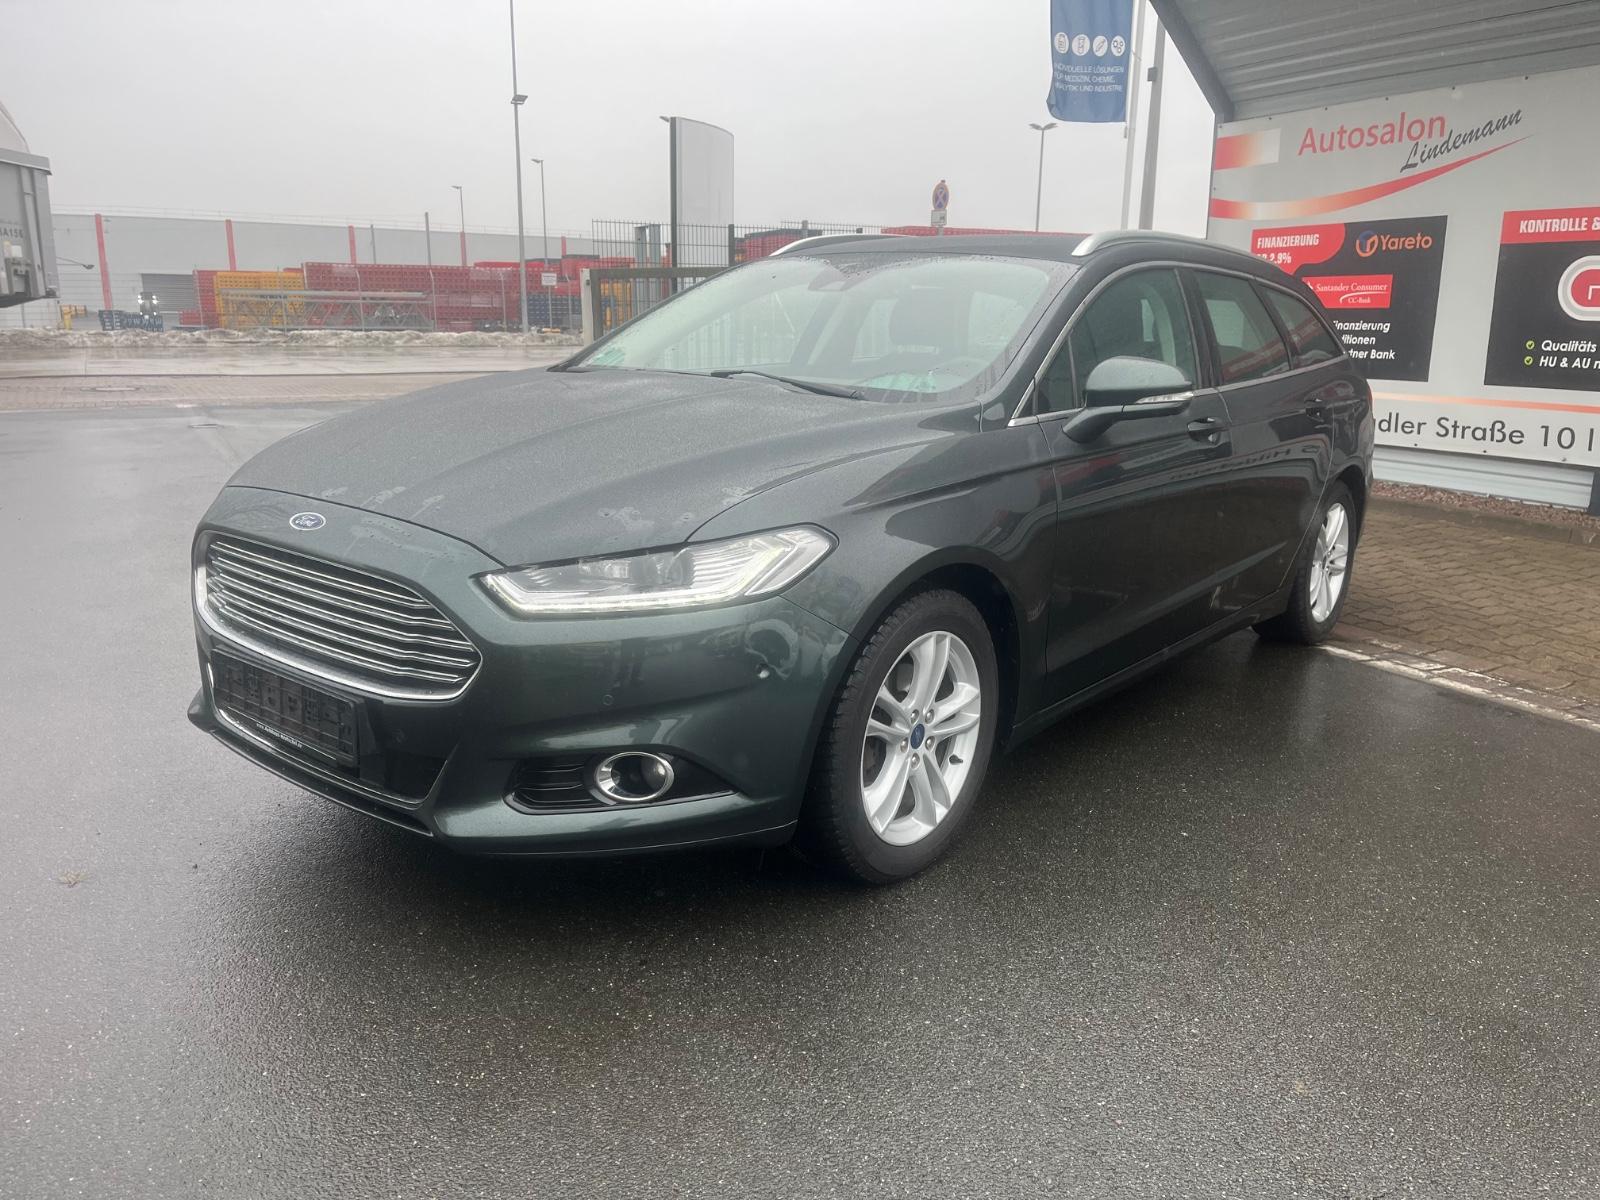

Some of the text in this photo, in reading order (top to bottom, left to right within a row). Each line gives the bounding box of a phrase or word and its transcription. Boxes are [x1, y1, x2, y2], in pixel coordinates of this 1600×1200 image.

[1298, 112, 1446, 156] Autosalon
[1400, 109, 1522, 173] Lindemann
[1520, 217, 1588, 233] KONTROLLE
[1257, 234, 1319, 249] FINANZIERUNG
[1380, 232, 1432, 250] Yareto
[1316, 283, 1388, 292] Santander Consumer
[1541, 340, 1597, 352] Qualitäts
[1370, 349, 1395, 359] Bank
[1539, 356, 1557, 367] HU
[1560, 357, 1568, 368] &
[1572, 357, 1591, 369] AU
[1436, 416, 1525, 444] Straße
[1540, 425, 1576, 449] 10
